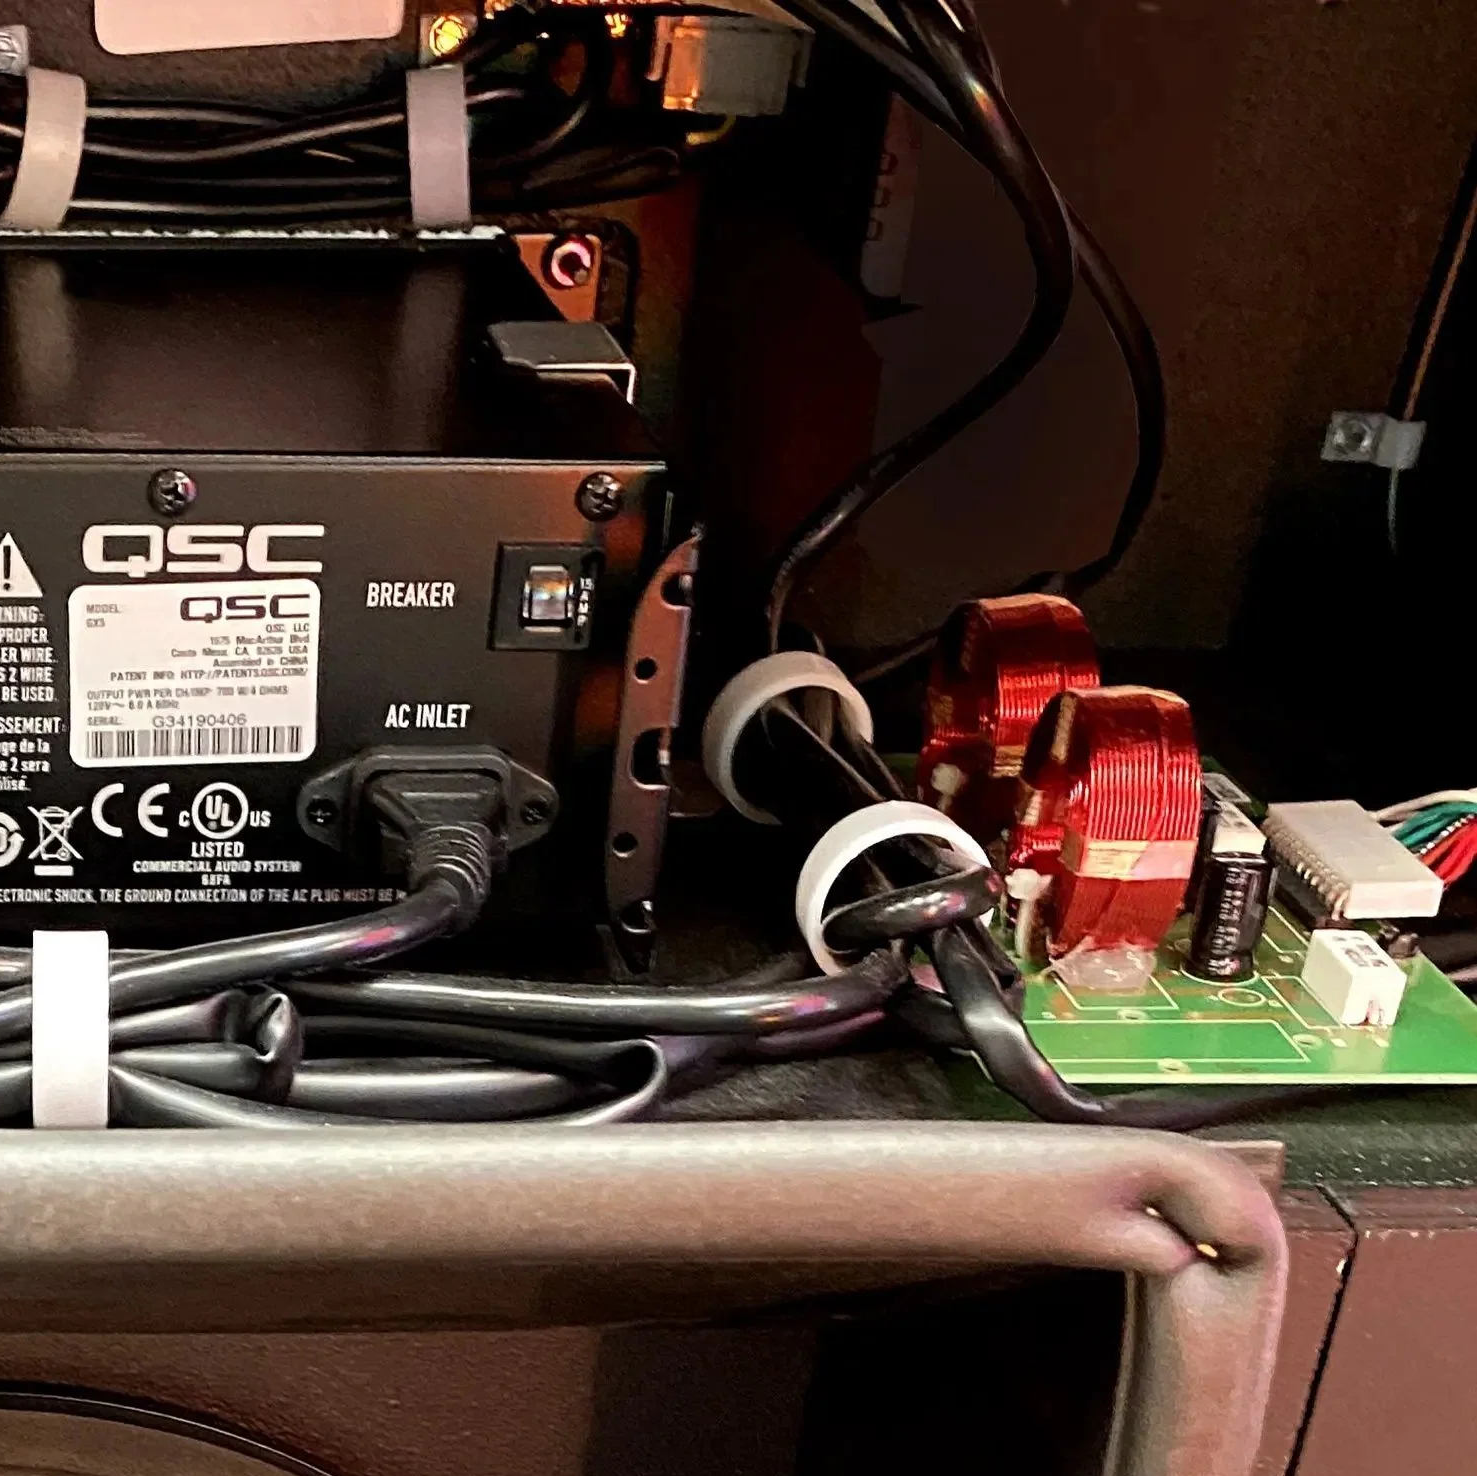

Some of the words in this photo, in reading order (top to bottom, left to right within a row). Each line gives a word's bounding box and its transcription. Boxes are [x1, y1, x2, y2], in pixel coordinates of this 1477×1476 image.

[81, 524, 325, 577] QSC
[366, 583, 455, 608] BREAKER
[180, 593, 311, 623] QSC
[235, 646, 249, 656] CA
[289, 645, 308, 654] USA
[8, 667, 18, 683] 2
[20, 667, 54, 683] WIRE
[110, 671, 147, 681] PATENT
[1, 686, 19, 702] BE
[87, 689, 124, 700] OUTPUT
[128, 689, 151, 699] PWR
[153, 688, 172, 698] PER
[152, 713, 247, 728] G34190406
[385, 703, 414, 727] AC
[417, 703, 471, 727] INLET
[19, 738, 35, 753] de
[37, 738, 51, 753] la
[10, 757, 19, 771] 2
[21, 760, 51, 772] sera
[249, 810, 272, 827] US
[191, 841, 245, 858] LISTED
[133, 860, 212, 873] COMMERCIAL
[214, 860, 252, 873] AUDIO
[254, 860, 302, 873] SYSTEM
[100, 888, 122, 903] THE
[124, 888, 172, 903] GROUND
[174, 888, 247, 903] CONNECTION
[249, 888, 265, 903] OF
[268, 888, 289, 903] THE
[292, 888, 309, 903] AC
[310, 888, 341, 903] PLUG
